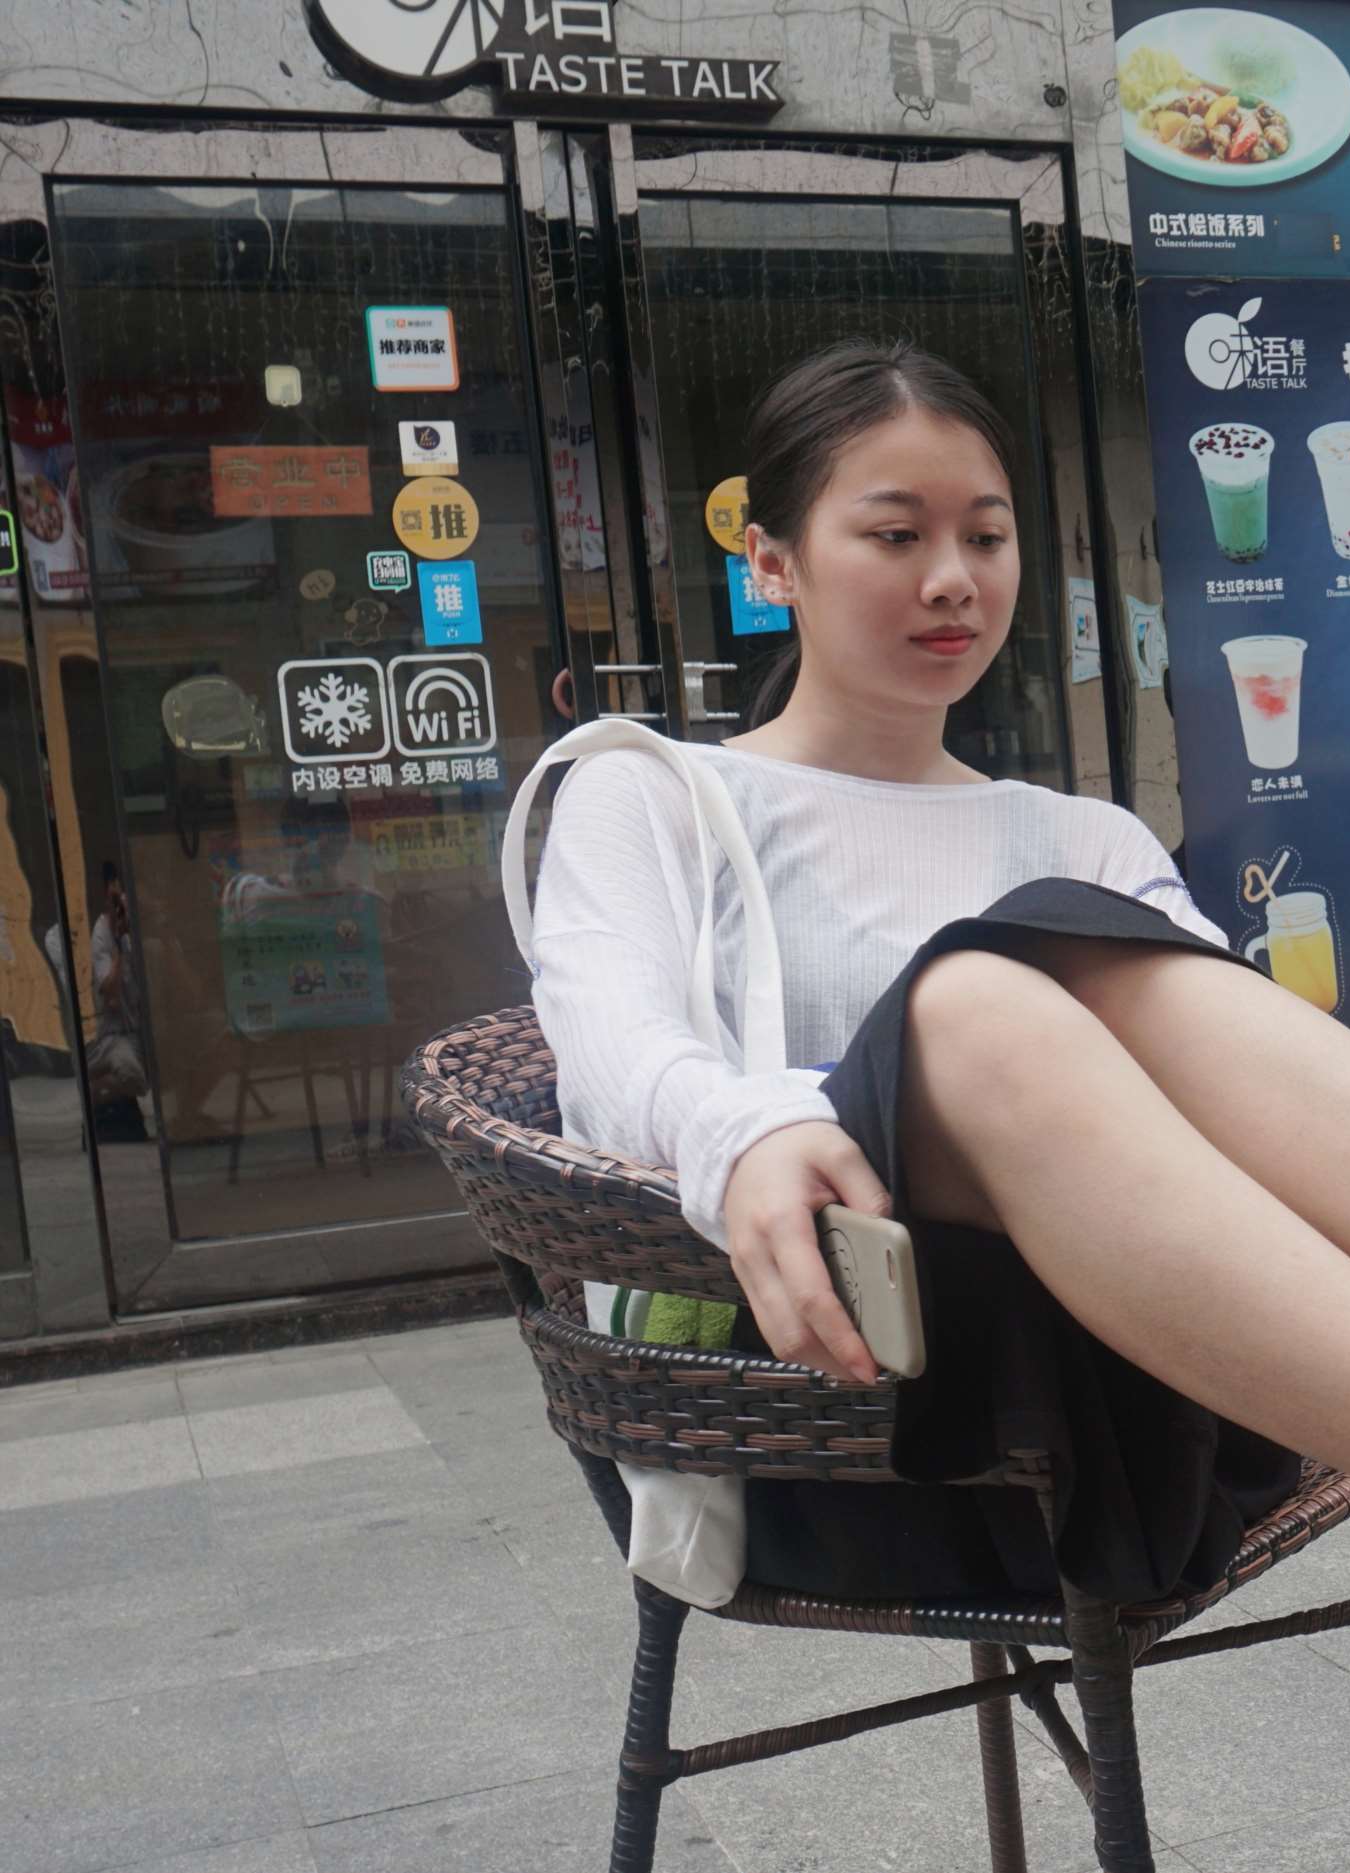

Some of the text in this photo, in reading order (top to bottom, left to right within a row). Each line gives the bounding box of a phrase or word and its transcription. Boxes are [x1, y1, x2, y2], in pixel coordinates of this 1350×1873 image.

[495, 52, 778, 100] TASTE TALK
[1149, 212, 1265, 237] 中式烩饭系列
[1155, 238, 1236, 249] Chinese risotto series
[380, 338, 446, 355] 推荐商家
[1245, 378, 1308, 389] TASTE TALK
[220, 455, 361, 489] 营业中
[429, 503, 469, 540] 推
[433, 584, 464, 613] 推
[292, 756, 499, 793] 内设空调 免费网络
[1250, 774, 1303, 792] 恋人未满
[1247, 794, 1270, 804] Lovers
[1295, 789, 1308, 799] full
